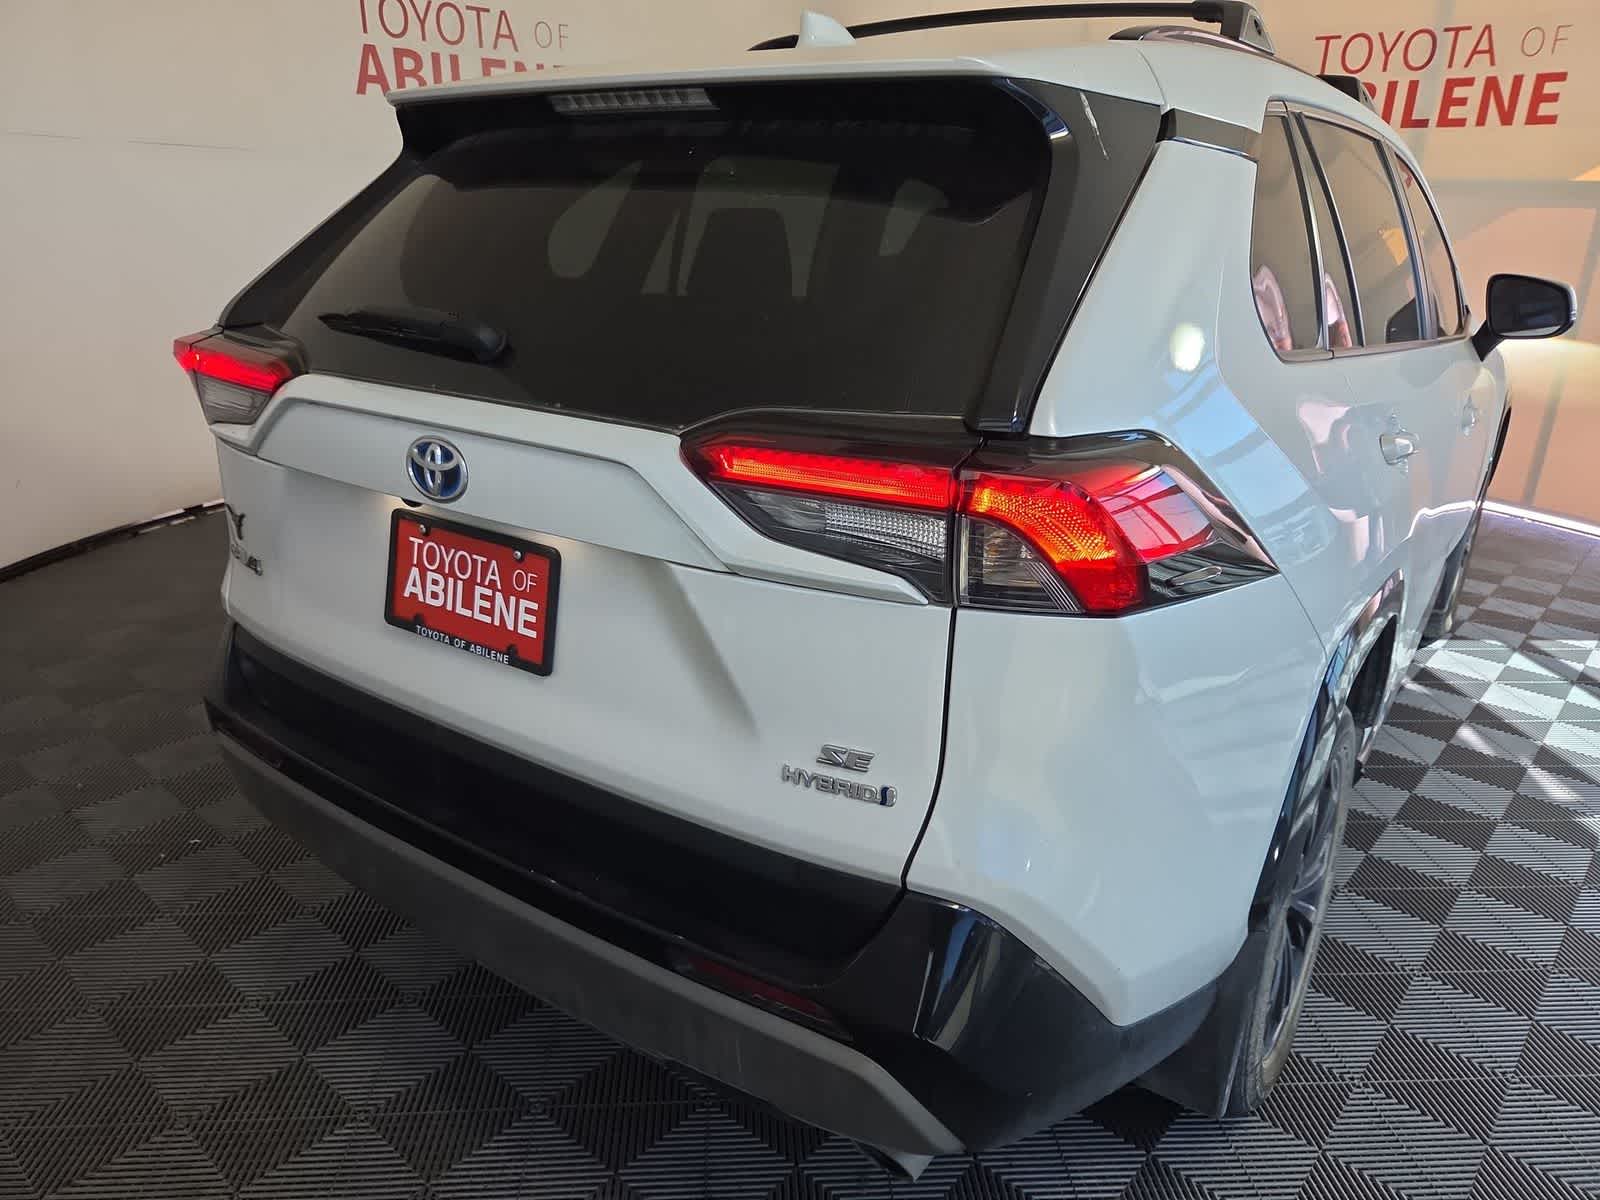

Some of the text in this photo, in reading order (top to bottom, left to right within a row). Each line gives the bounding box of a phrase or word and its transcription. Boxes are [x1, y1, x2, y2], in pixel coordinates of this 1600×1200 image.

[534, 21, 569, 49] OF
[1315, 23, 1574, 75] TOYOTA OF
[1362, 71, 1569, 129] ILENE
[409, 536, 539, 593] TOYOTA OF
[403, 566, 539, 639] ABILENE
[416, 624, 510, 665] TOYOTA OF ABILENE
[816, 744, 875, 773] SE
[782, 763, 879, 802] HYBRID
